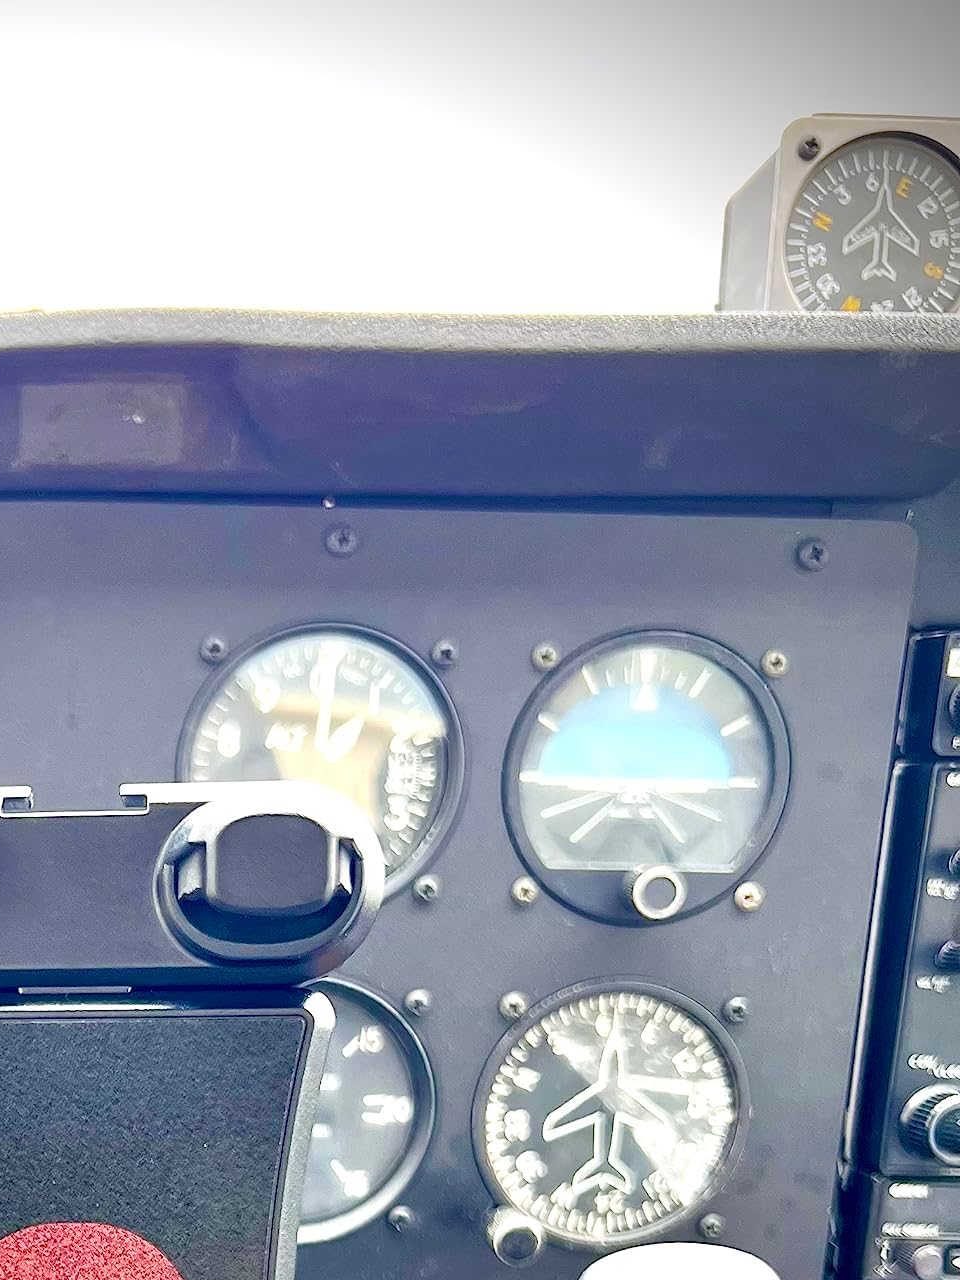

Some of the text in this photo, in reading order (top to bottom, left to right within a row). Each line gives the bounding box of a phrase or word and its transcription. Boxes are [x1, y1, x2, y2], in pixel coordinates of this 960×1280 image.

[865, 173, 879, 192] 6
[895, 176, 913, 199] E
[917, 197, 939, 219] 12
[812, 211, 833, 233] N
[929, 229, 949, 248] 15
[807, 243, 827, 267] 33
[816, 273, 840, 300] 30
